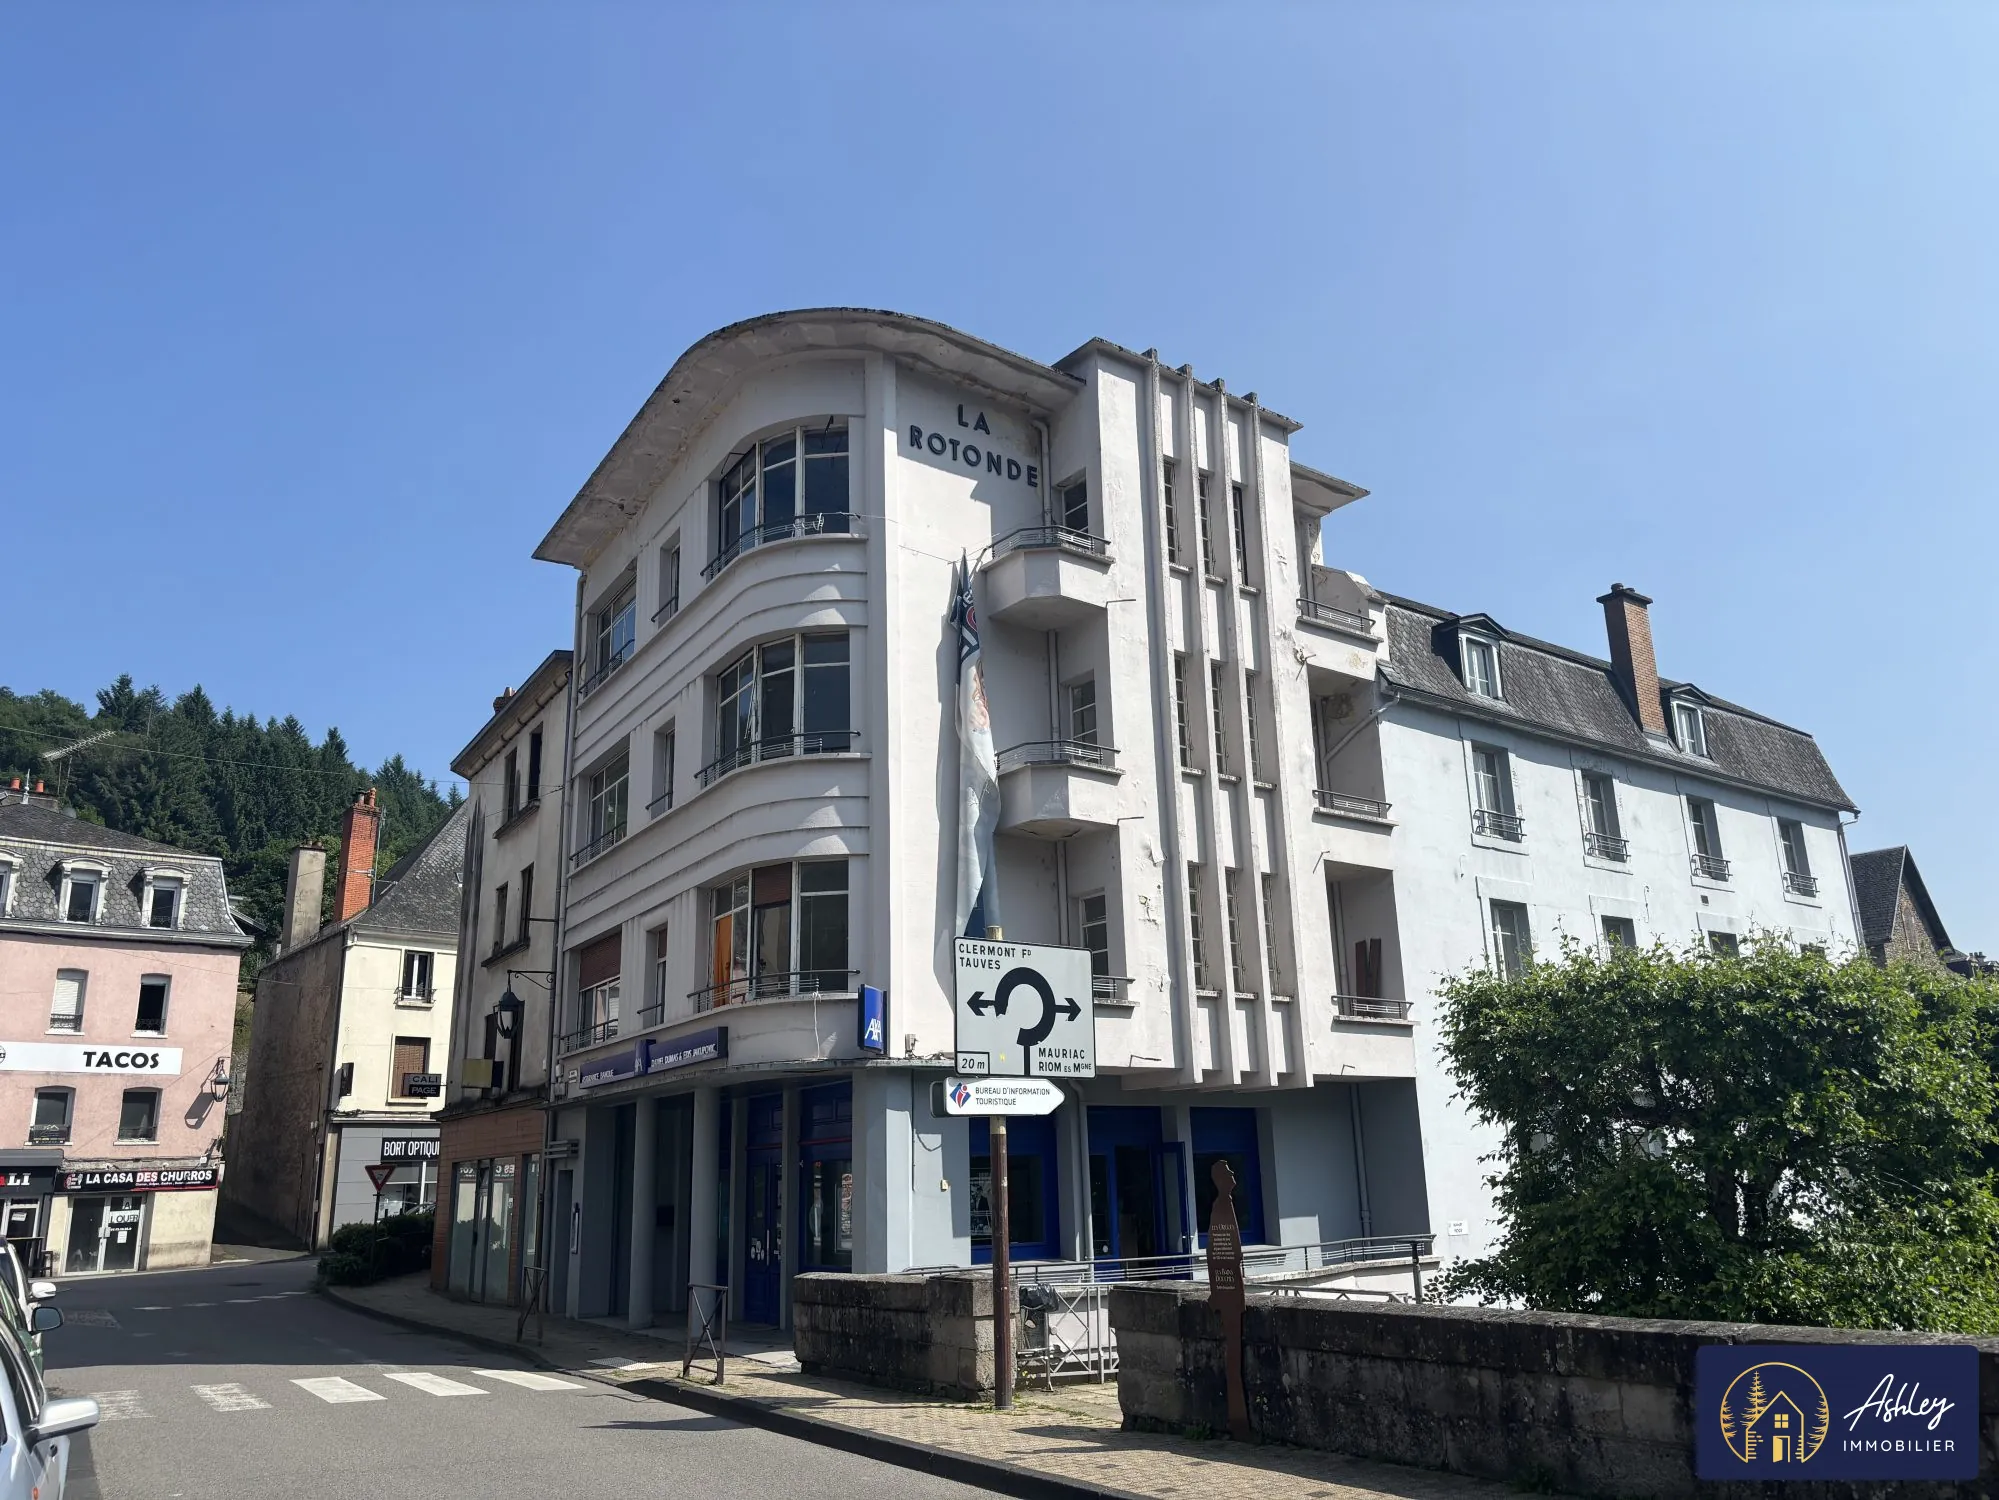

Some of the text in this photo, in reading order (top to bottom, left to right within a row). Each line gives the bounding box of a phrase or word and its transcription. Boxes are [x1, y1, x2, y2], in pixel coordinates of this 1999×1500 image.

[958, 404, 990, 435] LA
[910, 424, 1038, 488] ROTONDE
[958, 943, 1016, 958] CLERMONT
[960, 957, 1001, 970] TAUVES
[864, 1018, 882, 1042] AXA
[82, 1051, 160, 1069] TACOS
[1038, 1048, 1085, 1059] MAURIAC
[962, 1058, 985, 1069] 20 m
[1038, 1062, 1062, 1072] RIOM
[975, 1087, 1050, 1096] BUREAU D'INFORMATION
[976, 1098, 1016, 1106] TOURISTIQUE
[384, 1141, 440, 1158] BORT OPTIQU
[86, 1170, 212, 1184] LA CASA DES CHURROS
